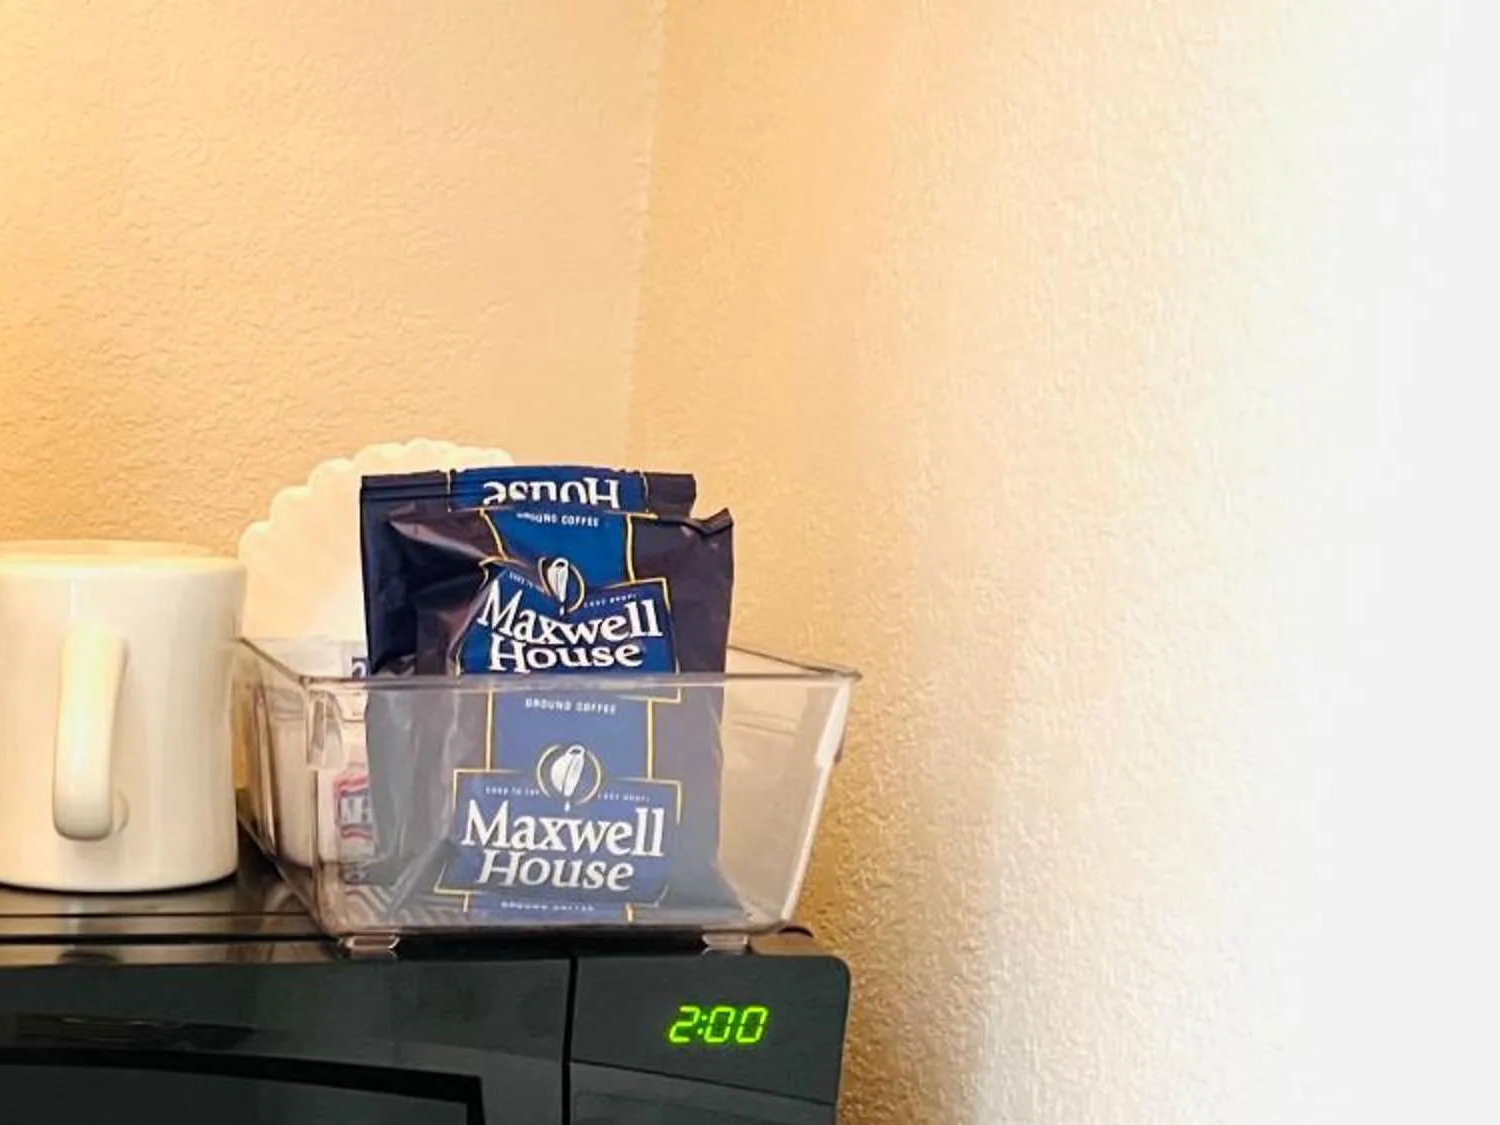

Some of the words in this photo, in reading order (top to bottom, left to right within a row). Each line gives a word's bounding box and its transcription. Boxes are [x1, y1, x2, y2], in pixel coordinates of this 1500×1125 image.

[561, 514, 599, 528] COFFEE
[476, 578, 663, 646] Maxwell
[487, 632, 643, 673] House
[461, 799, 666, 857] Maxwell
[476, 848, 635, 892] House
[668, 1006, 768, 1043] 2:00
